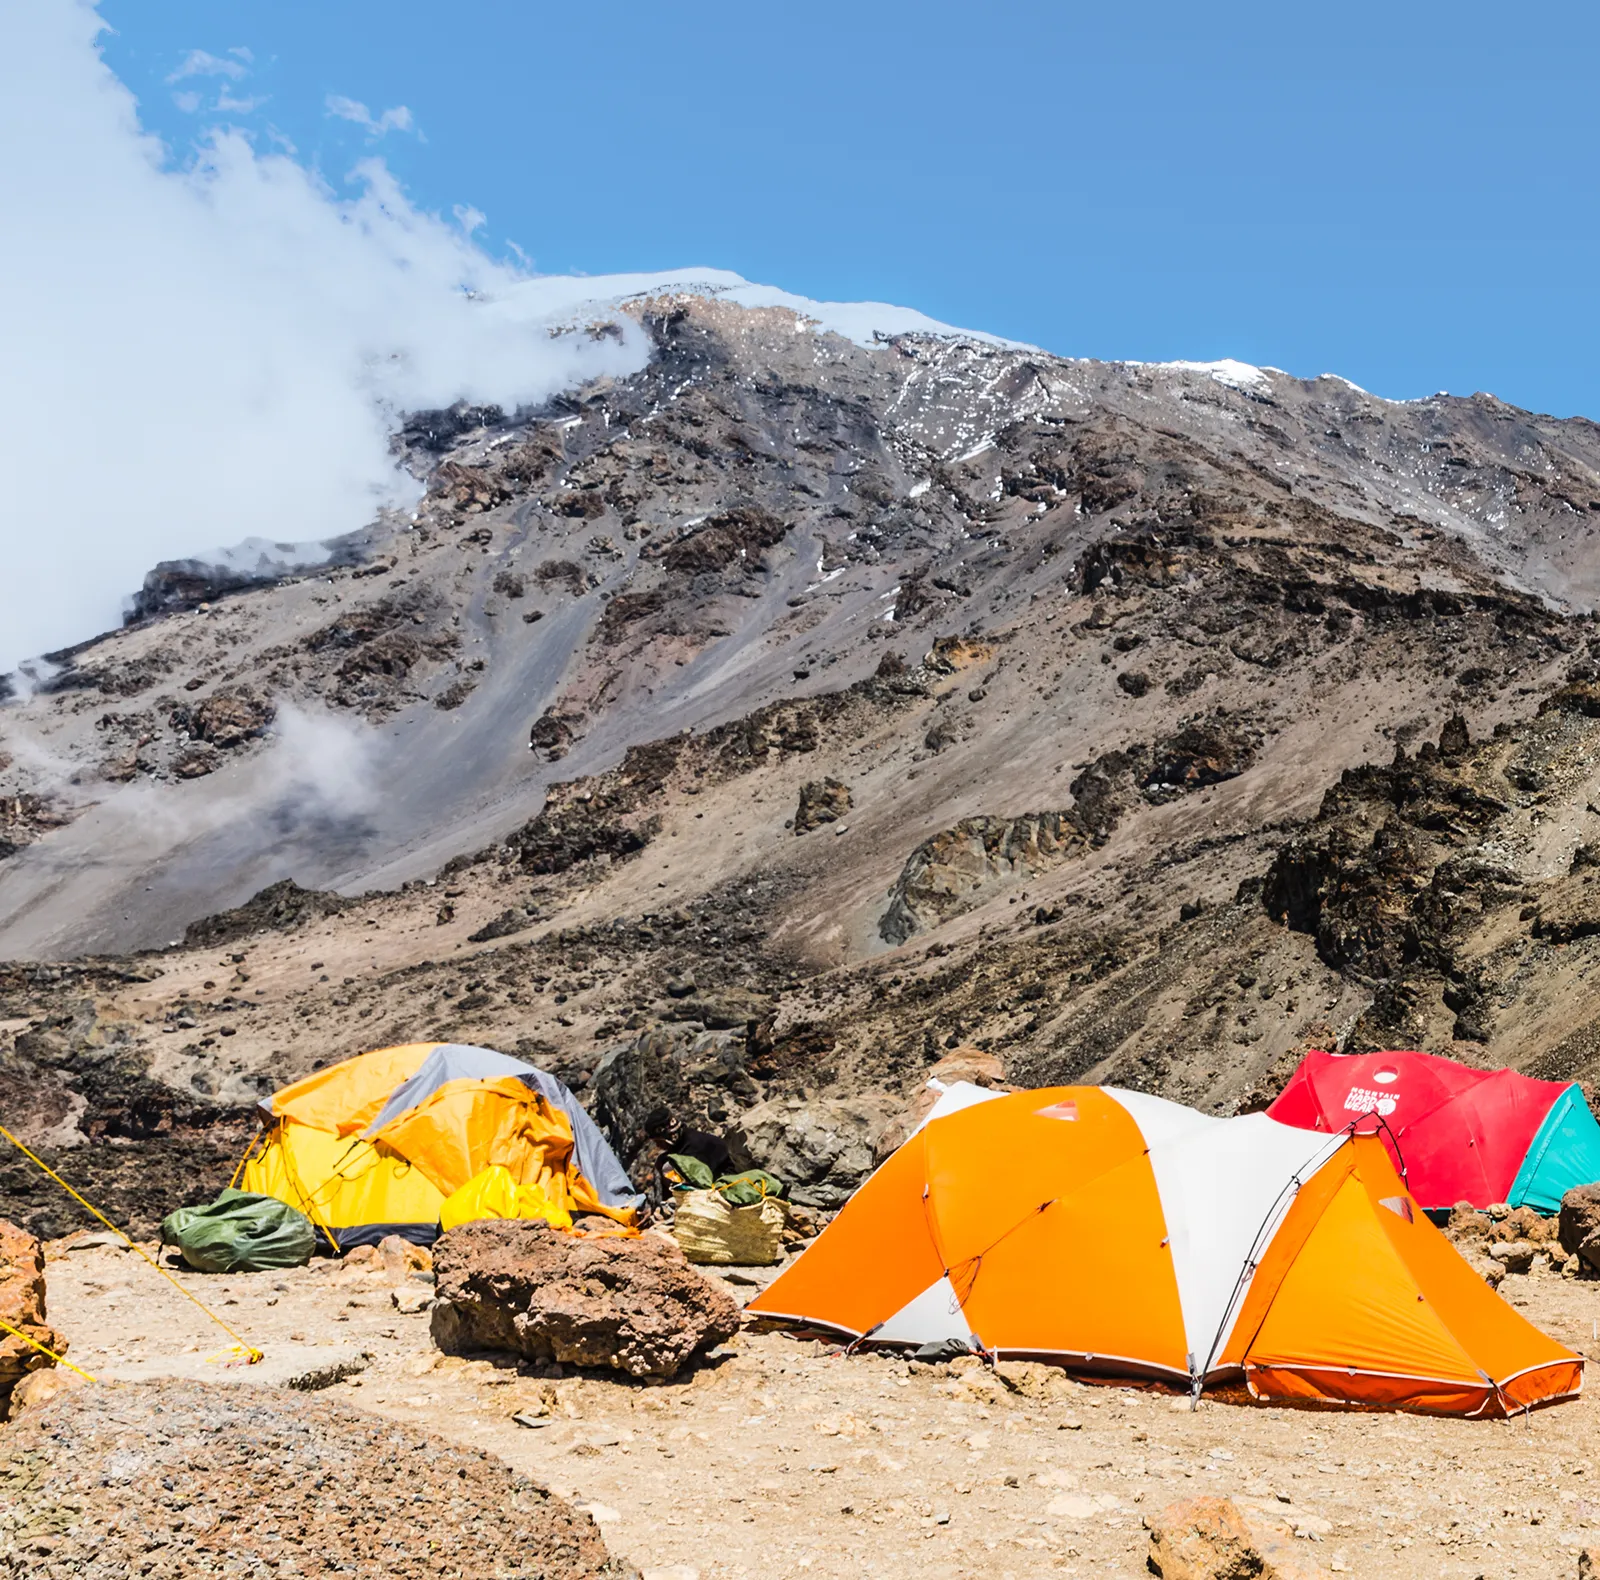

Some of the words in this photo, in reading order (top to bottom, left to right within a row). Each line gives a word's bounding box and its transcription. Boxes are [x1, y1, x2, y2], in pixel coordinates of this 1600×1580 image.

[1346, 1092, 1378, 1105] HARD
[1351, 1086, 1400, 1100] MOUNTAIN
[1344, 1099, 1376, 1113] WEAR
